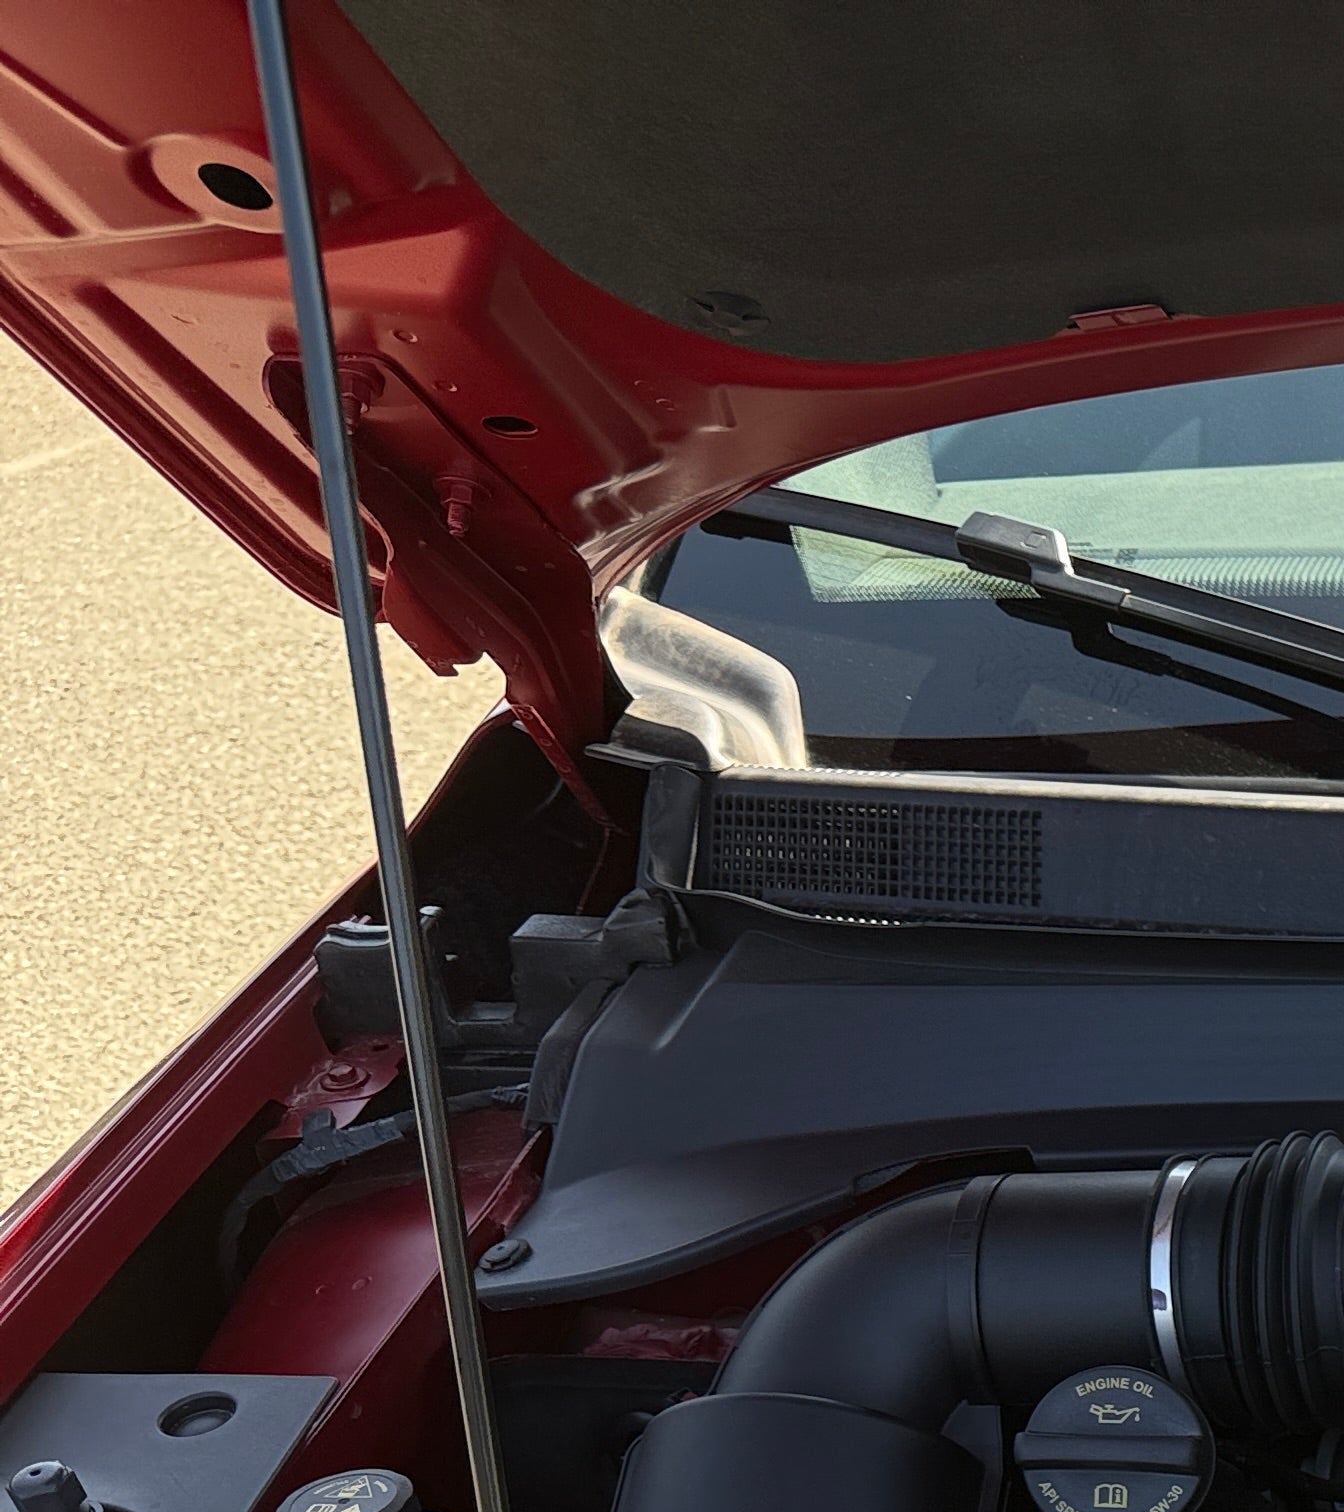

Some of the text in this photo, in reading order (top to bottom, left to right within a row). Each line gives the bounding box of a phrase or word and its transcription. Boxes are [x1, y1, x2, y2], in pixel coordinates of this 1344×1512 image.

[1075, 1377, 1155, 1399] ENGINE OIL
[1038, 1482, 1056, 1504] API
